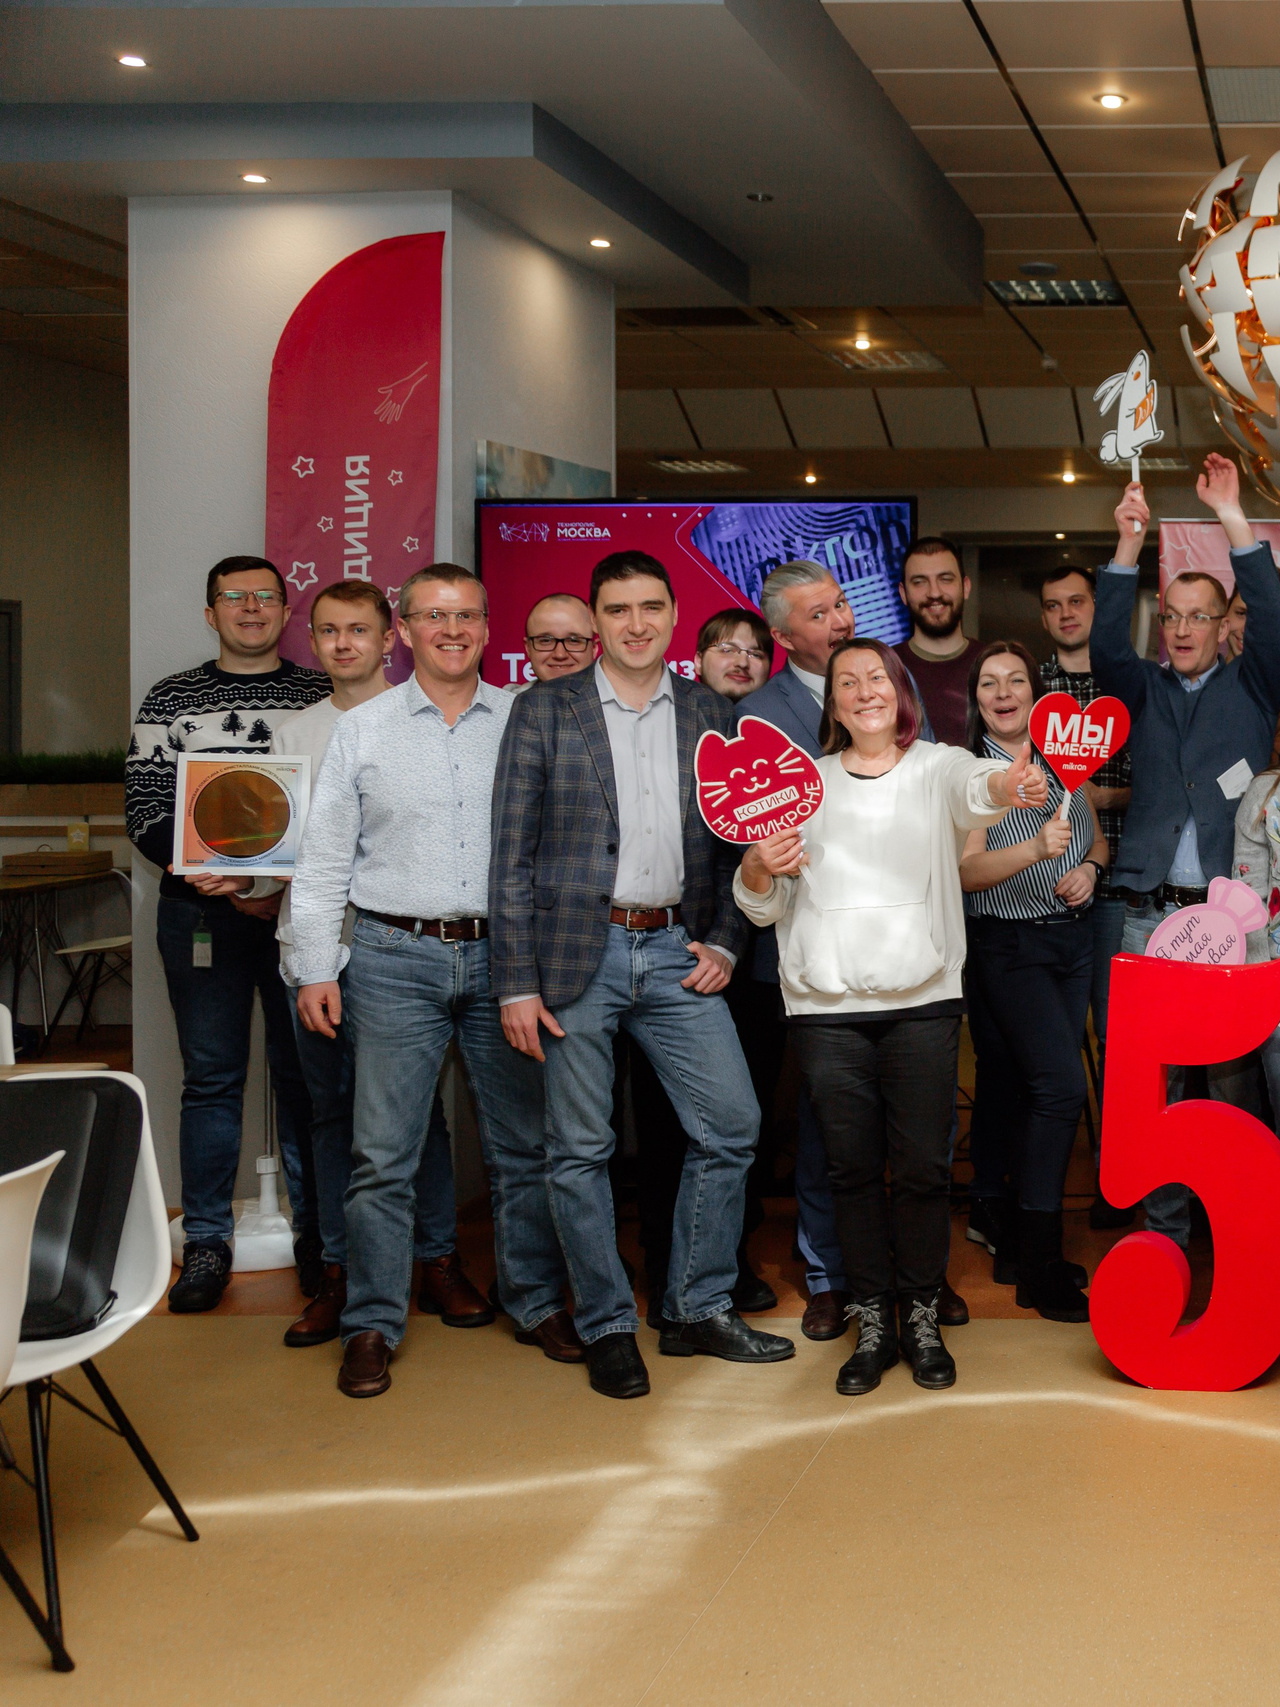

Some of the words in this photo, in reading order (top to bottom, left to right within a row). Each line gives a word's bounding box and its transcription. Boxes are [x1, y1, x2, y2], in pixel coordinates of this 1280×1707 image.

[343, 455, 373, 582] ДИЦИЯ
[556, 527, 611, 538] МОСКВА
[1045, 712, 1114, 745] МЫ
[1043, 742, 1110, 758] ВМЕСТЕ
[711, 815, 739, 839] НА
[745, 779, 821, 840] МИКРОНЕ
[736, 788, 797, 819] КОТИКИ
[1170, 915, 1200, 944] тут
